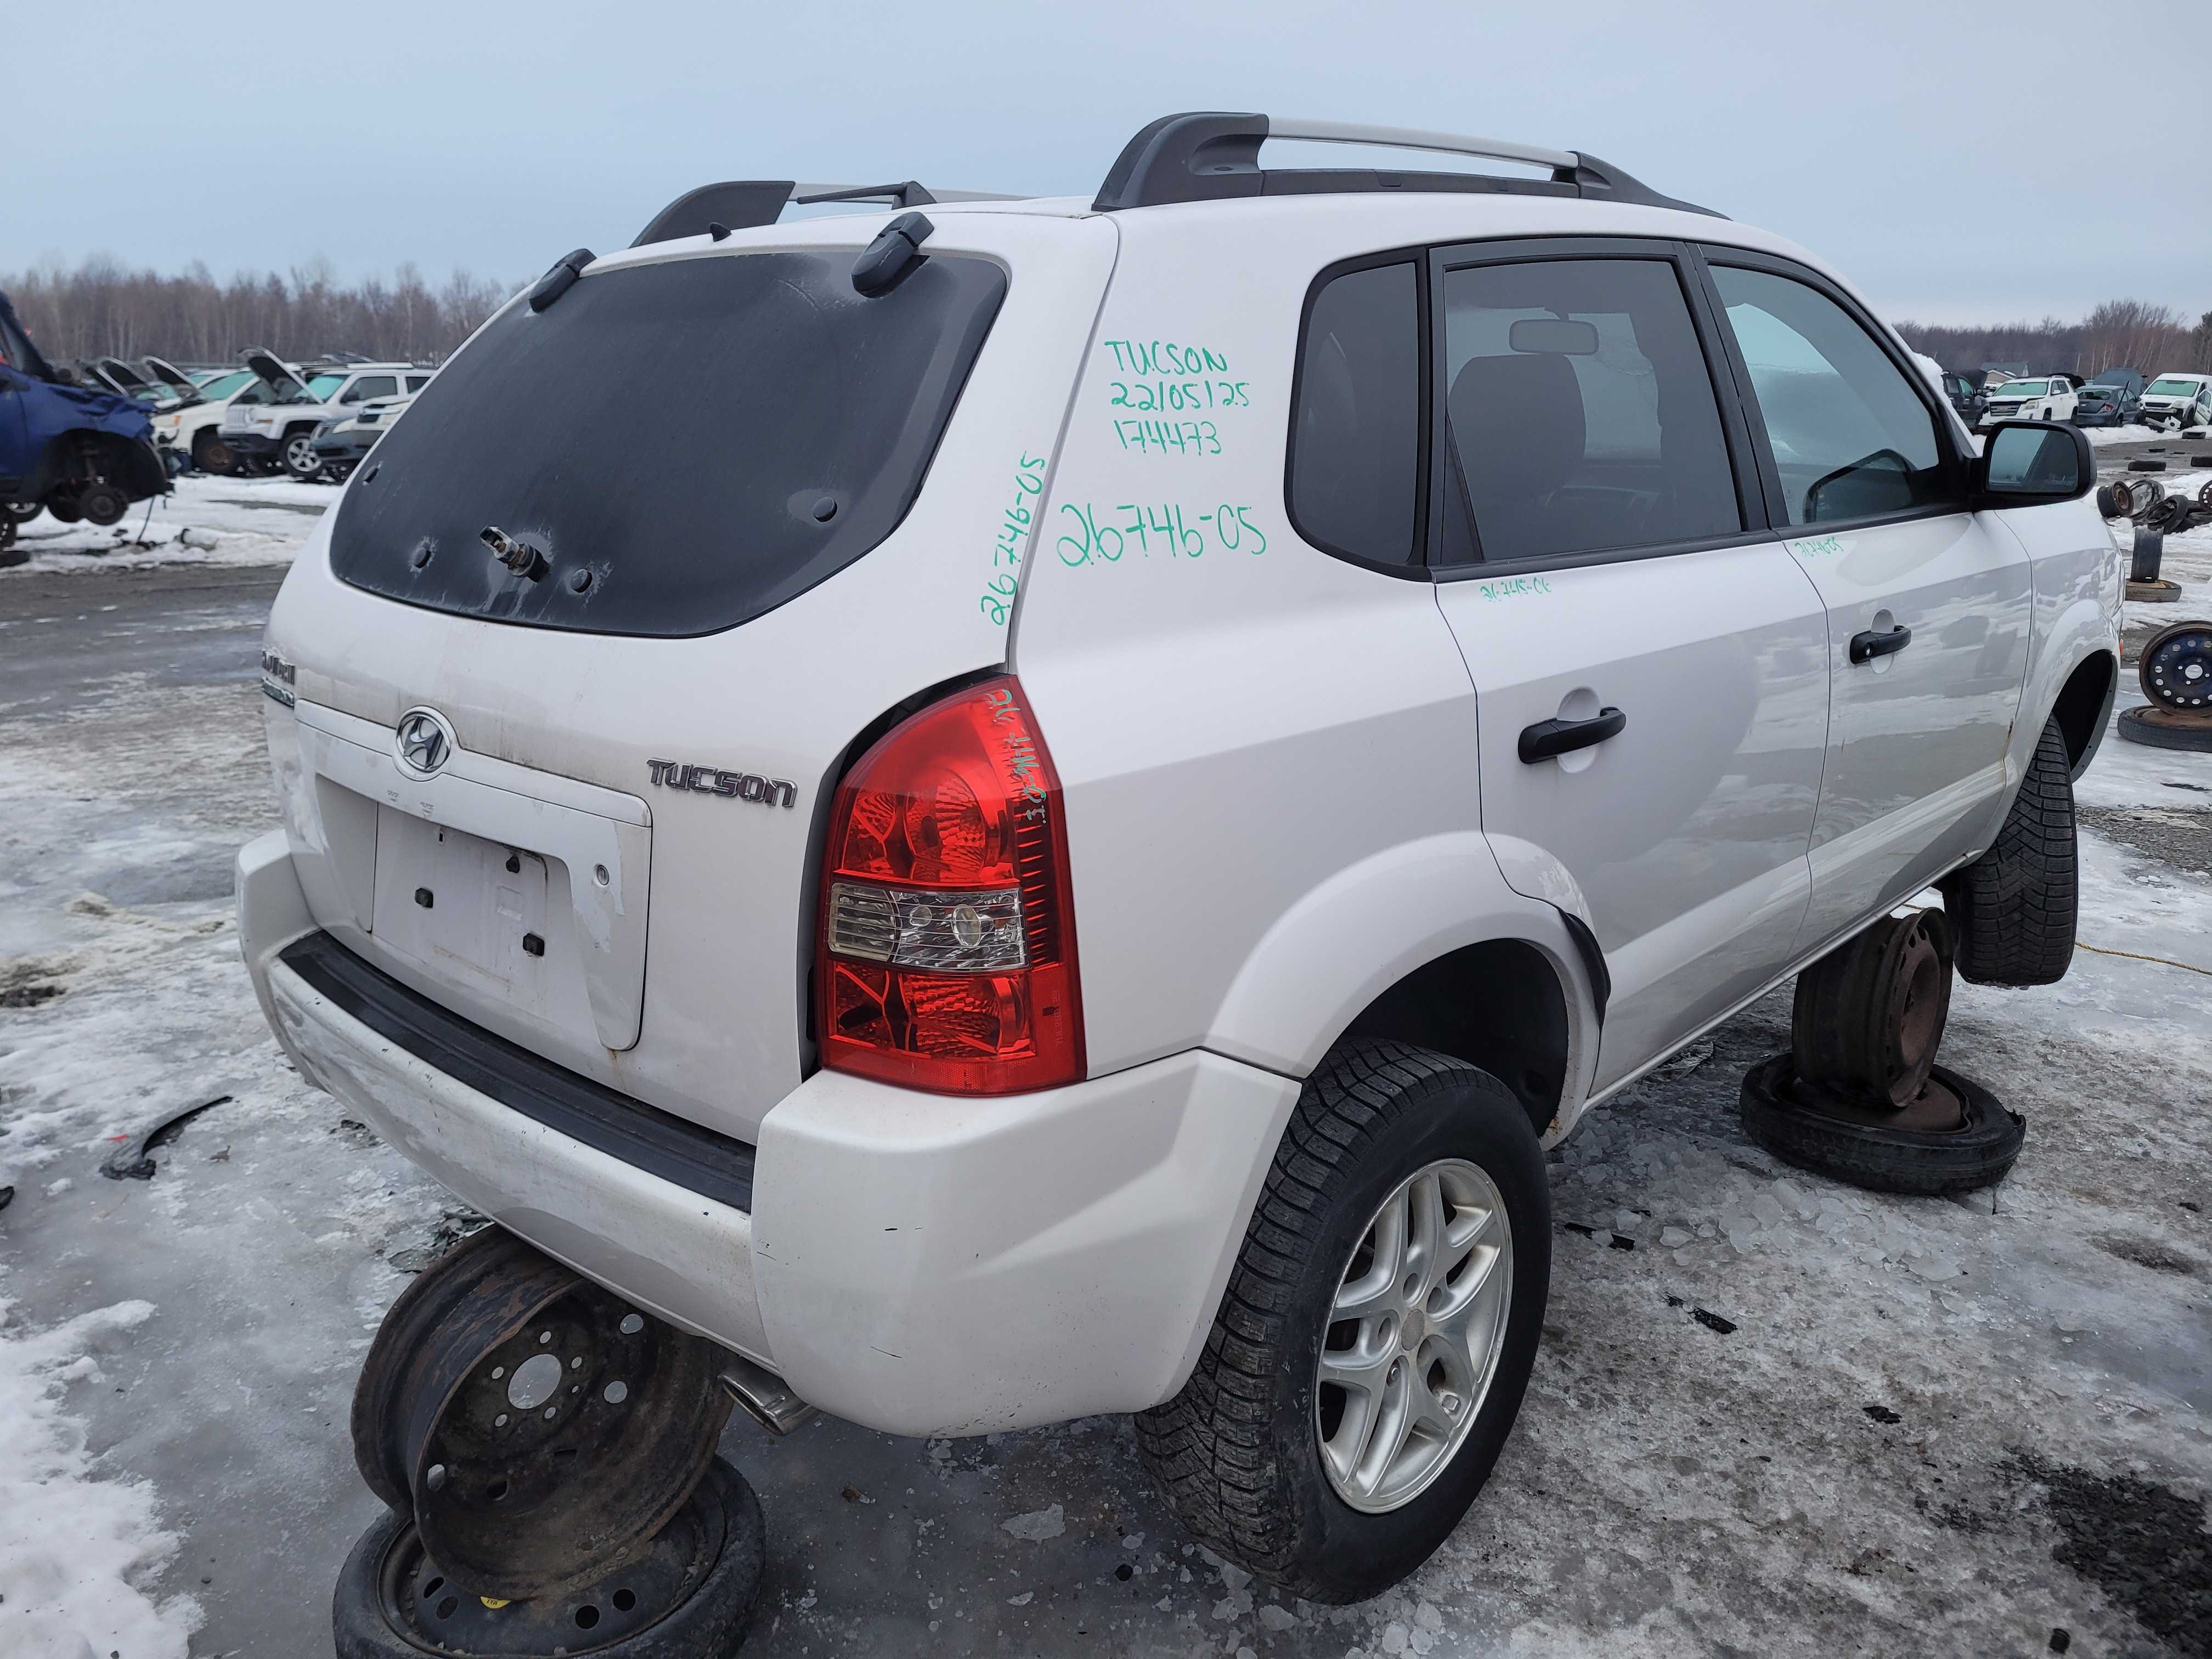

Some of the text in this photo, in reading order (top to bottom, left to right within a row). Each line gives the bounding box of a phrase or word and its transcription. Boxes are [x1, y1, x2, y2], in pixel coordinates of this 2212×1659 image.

[1104, 340, 1228, 376] TUCSON
[1114, 419, 1222, 456] 174473
[980, 451, 1045, 625] 26746-05
[1057, 503, 1267, 567] 26746-05
[646, 757, 798, 808] TUCSON
